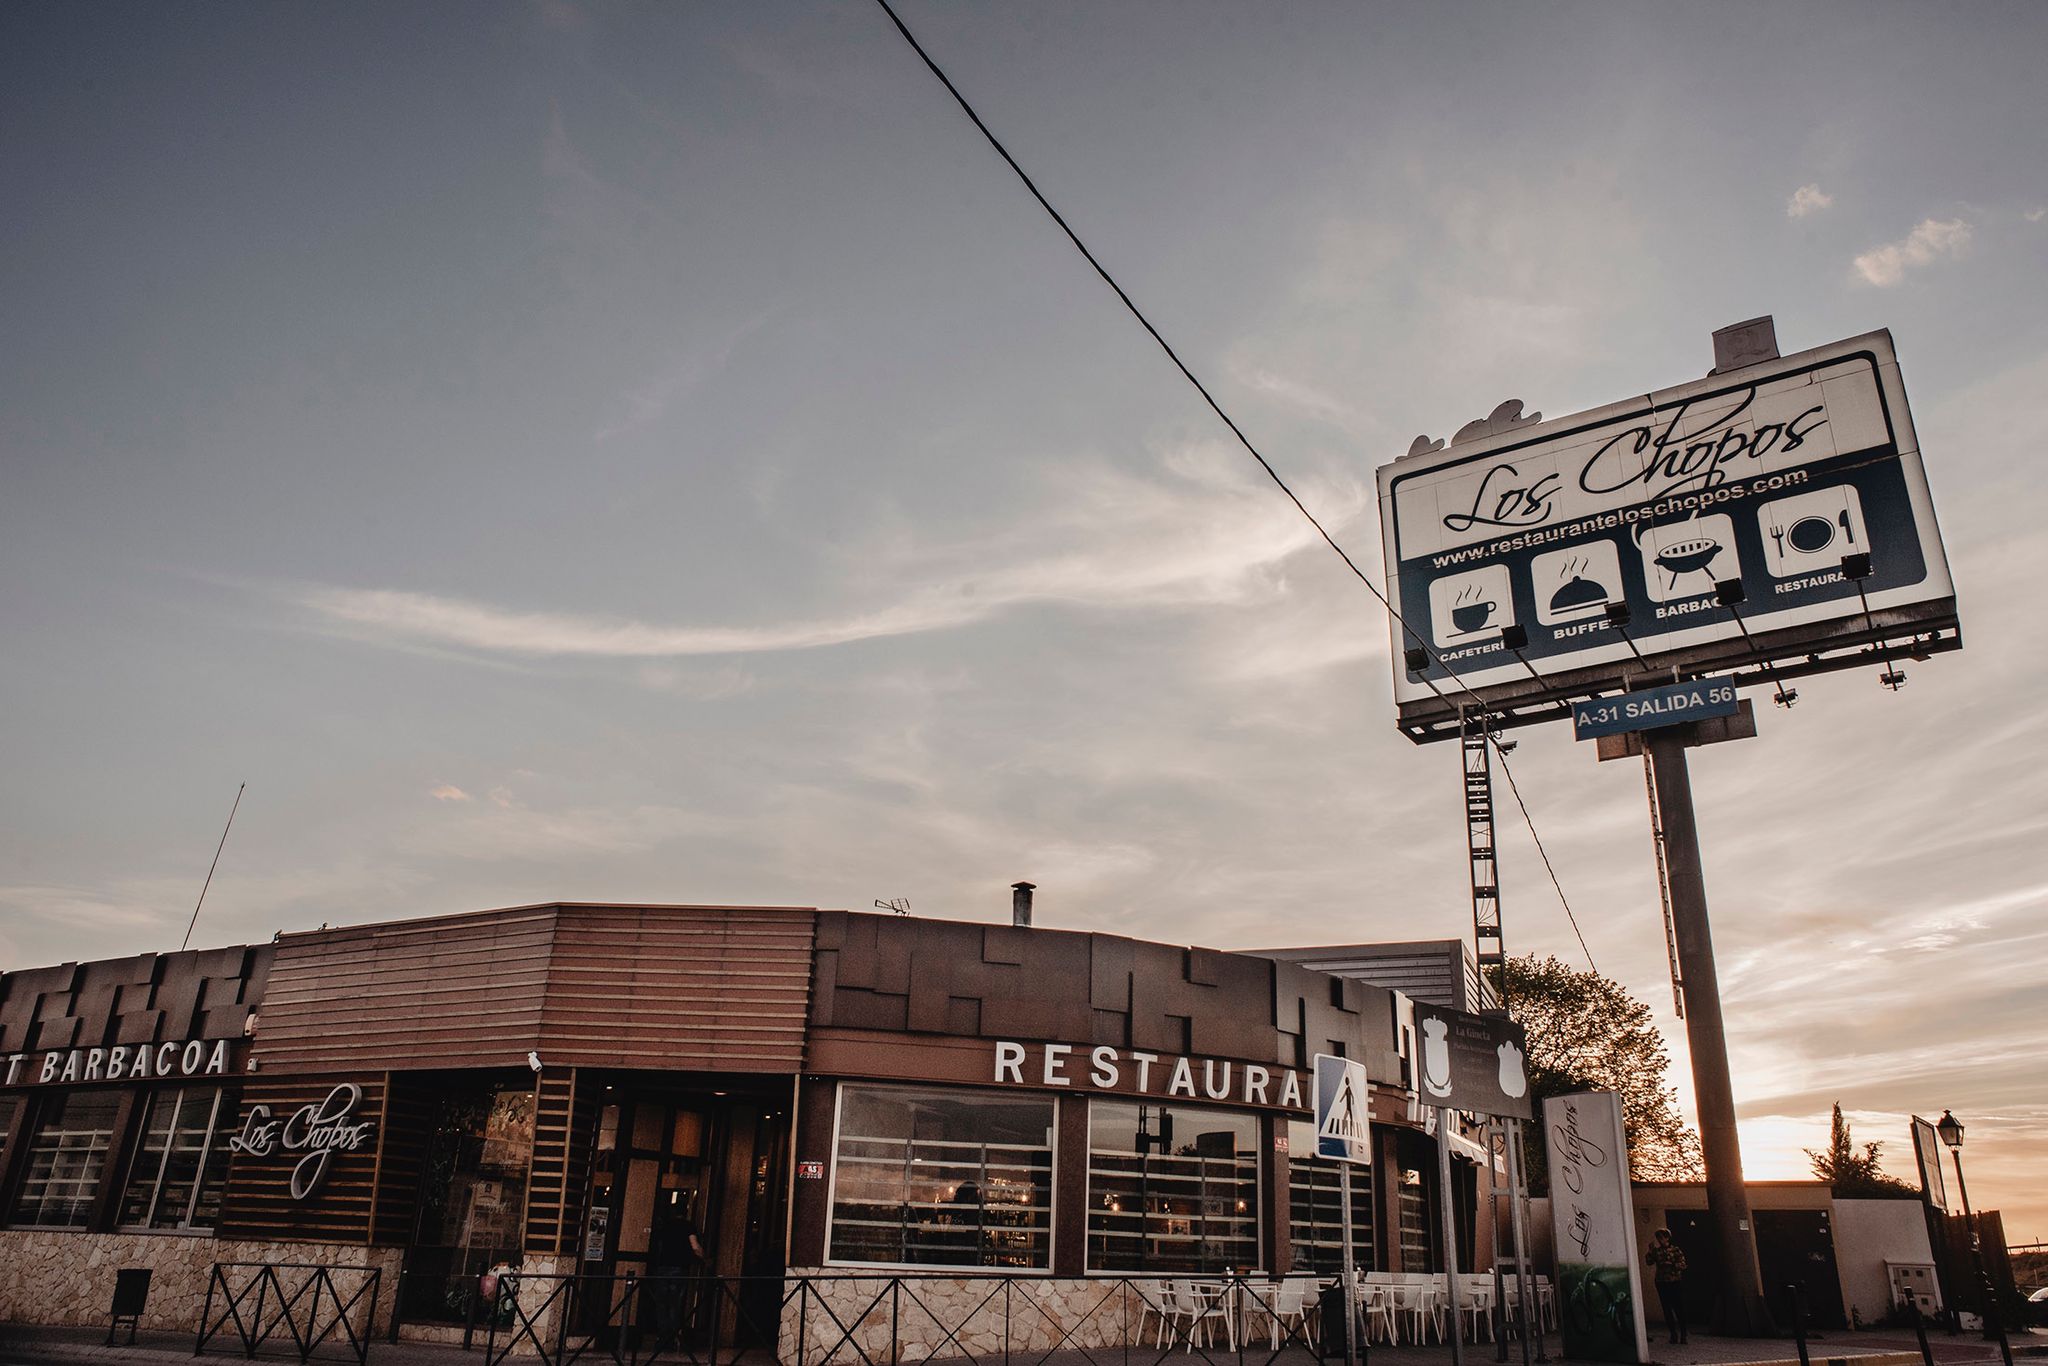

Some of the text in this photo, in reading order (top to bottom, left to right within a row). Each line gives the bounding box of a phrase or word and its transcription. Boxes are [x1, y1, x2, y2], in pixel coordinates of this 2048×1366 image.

[1443, 387, 1828, 545] Los Chopos
[1432, 467, 1808, 569] www.restauranteloschopos.com
[1775, 571, 1846, 594] RESTAURA
[1553, 617, 1612, 640] BUFFE
[1655, 596, 1722, 619] BARBAC
[1440, 640, 1505, 662] CAFETERI
[1577, 686, 1732, 727] A-31 SALIDA 56
[39, 1040, 228, 1084] BARBACOA
[229, 1082, 375, 1200] Los Chopos
[1552, 1099, 1608, 1260] Los Chopos
